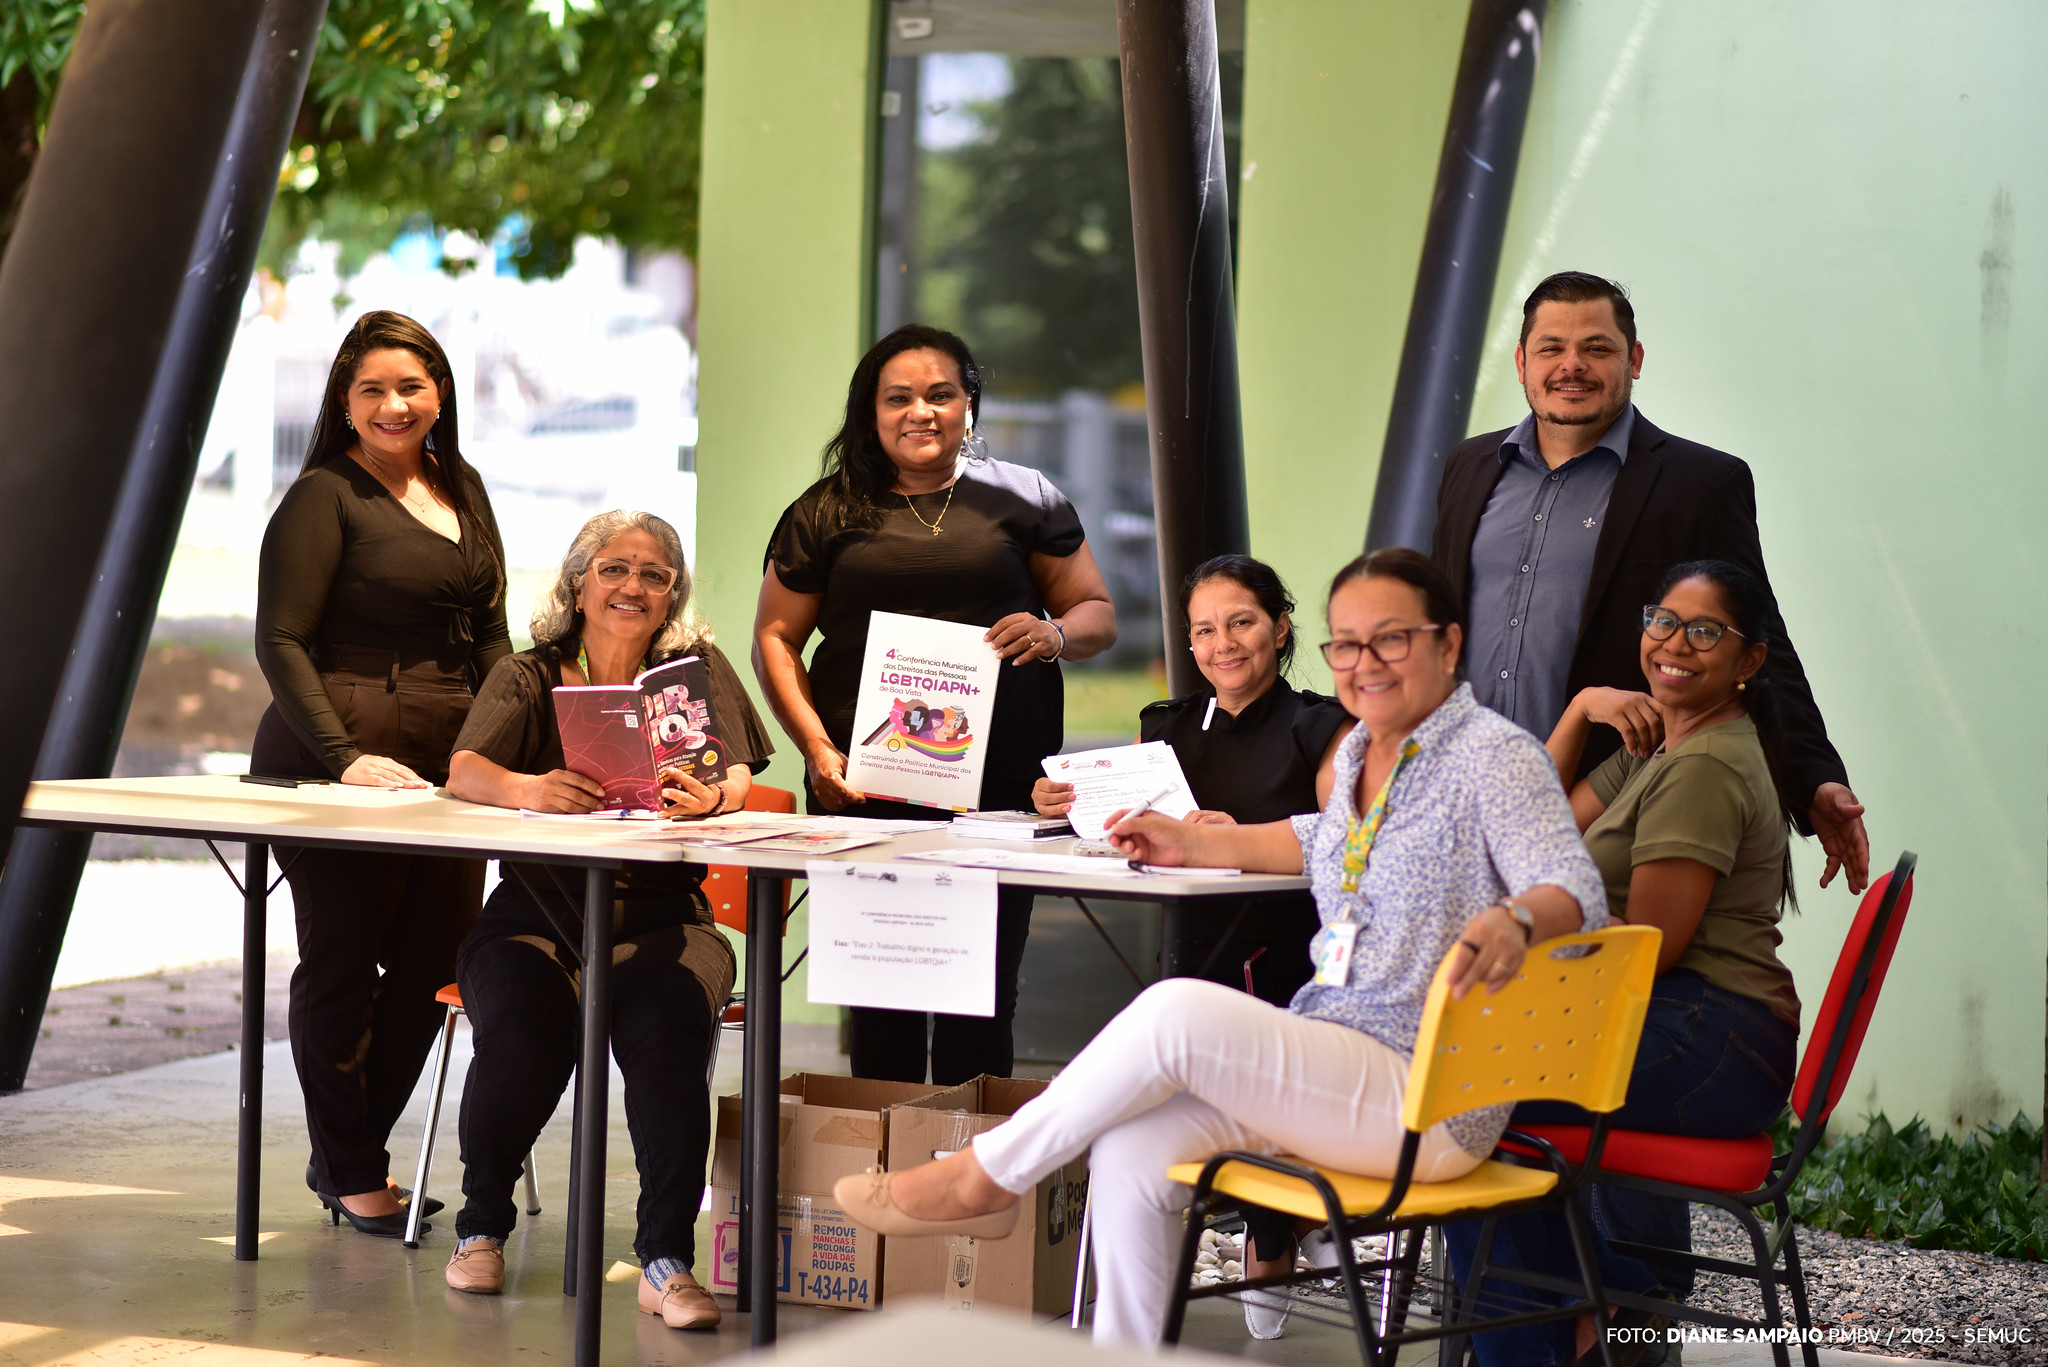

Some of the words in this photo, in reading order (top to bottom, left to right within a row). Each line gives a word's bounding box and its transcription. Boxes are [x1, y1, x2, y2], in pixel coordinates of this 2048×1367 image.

[897, 654, 940, 667] Conferência
[942, 661, 977, 672] Municipal
[898, 664, 923, 674] Direitos
[939, 670, 967, 680] Pessoas
[881, 672, 980, 695] LGBTQIAPN+
[905, 688, 922, 697] Vista
[861, 753, 898, 763] Construindo
[905, 759, 928, 768] Política
[929, 763, 959, 772] Municipal
[860, 760, 882, 768] Direitos
[896, 766, 920, 774] Pessoas
[922, 770, 960, 779] LGBTQIAPN+
[876, 942, 906, 951] Trabalho
[907, 945, 926, 954] digno
[932, 947, 959, 955] geração
[877, 955, 914, 965] população
[1066, 1180, 1086, 1207] Pag
[814, 1224, 856, 1237] REMOVE
[813, 1235, 849, 1245] MANCHAS
[813, 1243, 856, 1254] PROLONGA
[820, 1252, 838, 1260] VIDA
[840, 1254, 855, 1262] DAS
[812, 1259, 855, 1272] ROUPAS
[799, 1272, 868, 1303] T-434-P4
